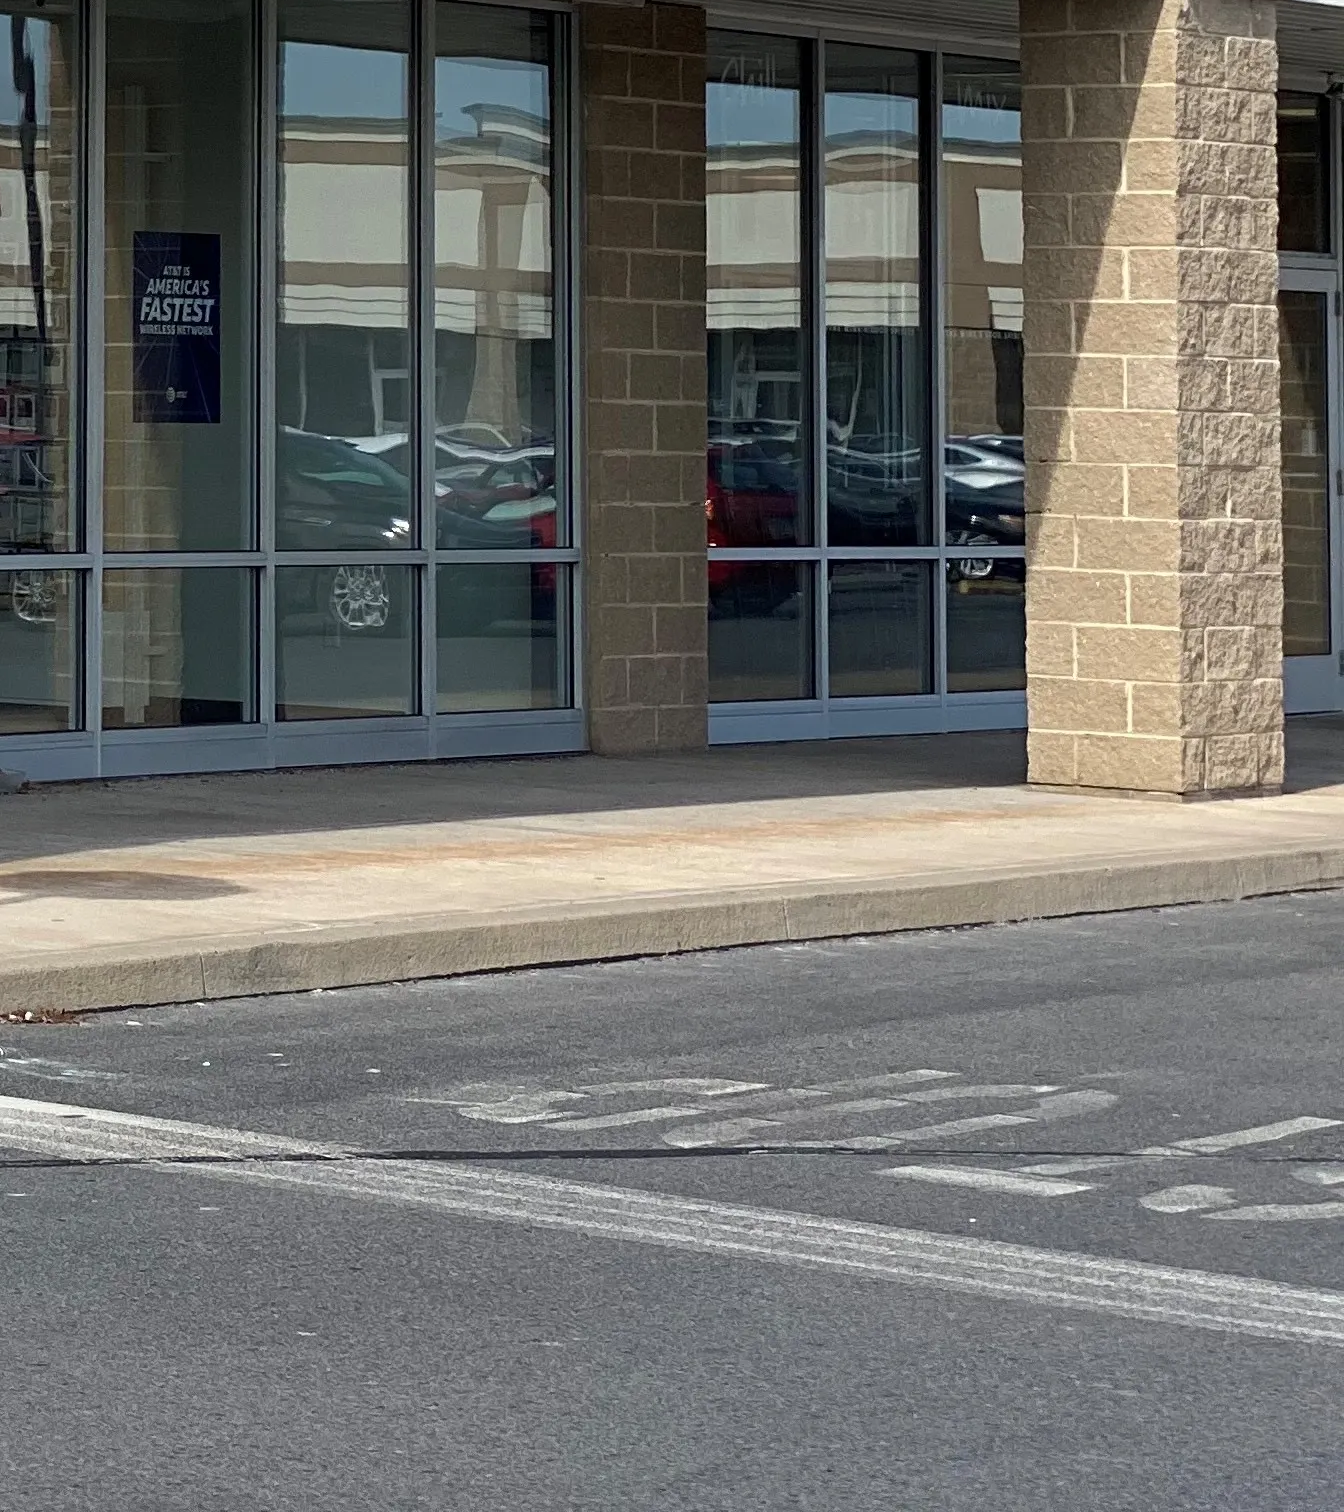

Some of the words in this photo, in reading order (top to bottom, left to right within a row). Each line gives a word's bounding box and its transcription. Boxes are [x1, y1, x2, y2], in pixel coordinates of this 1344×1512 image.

[146, 278, 210, 296] AMERICA'S
[140, 297, 214, 323] FASTEST
[139, 323, 175, 335] WIRELESS
[176, 324, 214, 336] NETWORK
